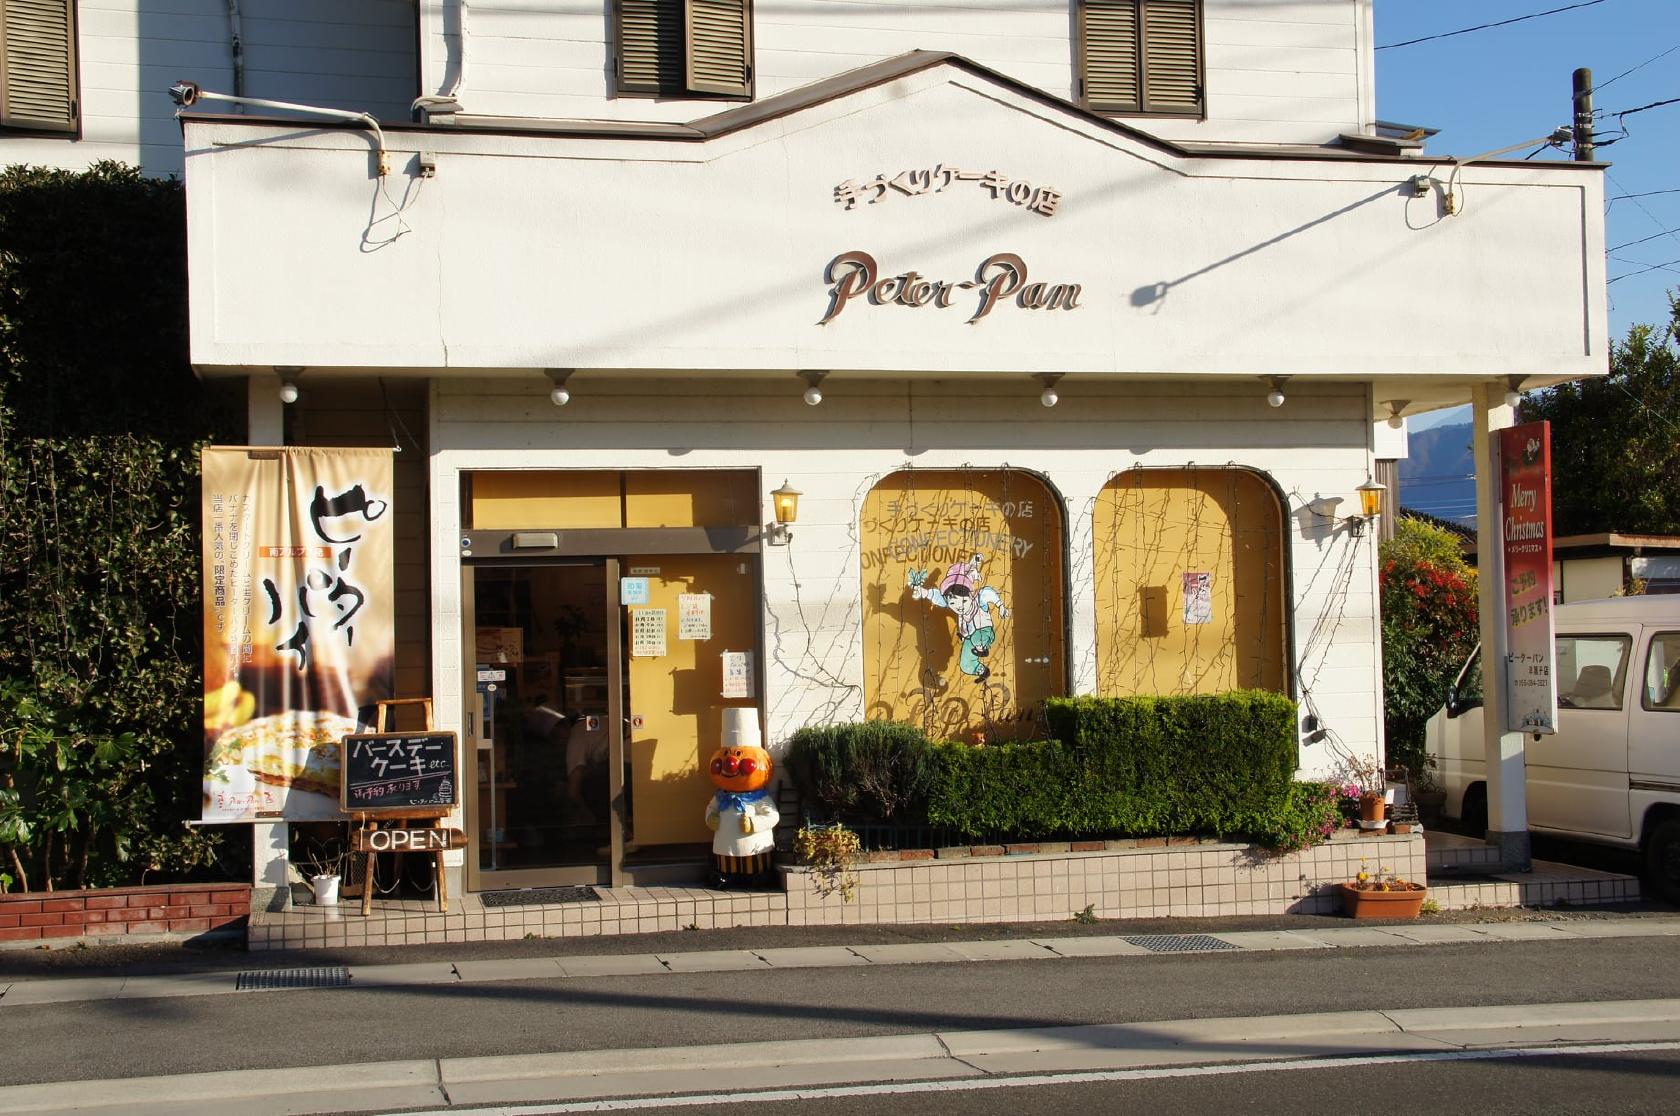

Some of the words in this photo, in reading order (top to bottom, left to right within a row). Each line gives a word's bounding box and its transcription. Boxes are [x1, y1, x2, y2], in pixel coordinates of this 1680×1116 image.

[834, 162, 1062, 217] 手づくりケーキの店
[1510, 483, 1537, 512] Merry
[887, 500, 1033, 518] 手づくりケーキの店
[1505, 515, 1544, 543] Christmas
[352, 738, 442, 758] バースデー
[370, 756, 426, 777] ケーキ
[370, 829, 447, 850] OPEN
